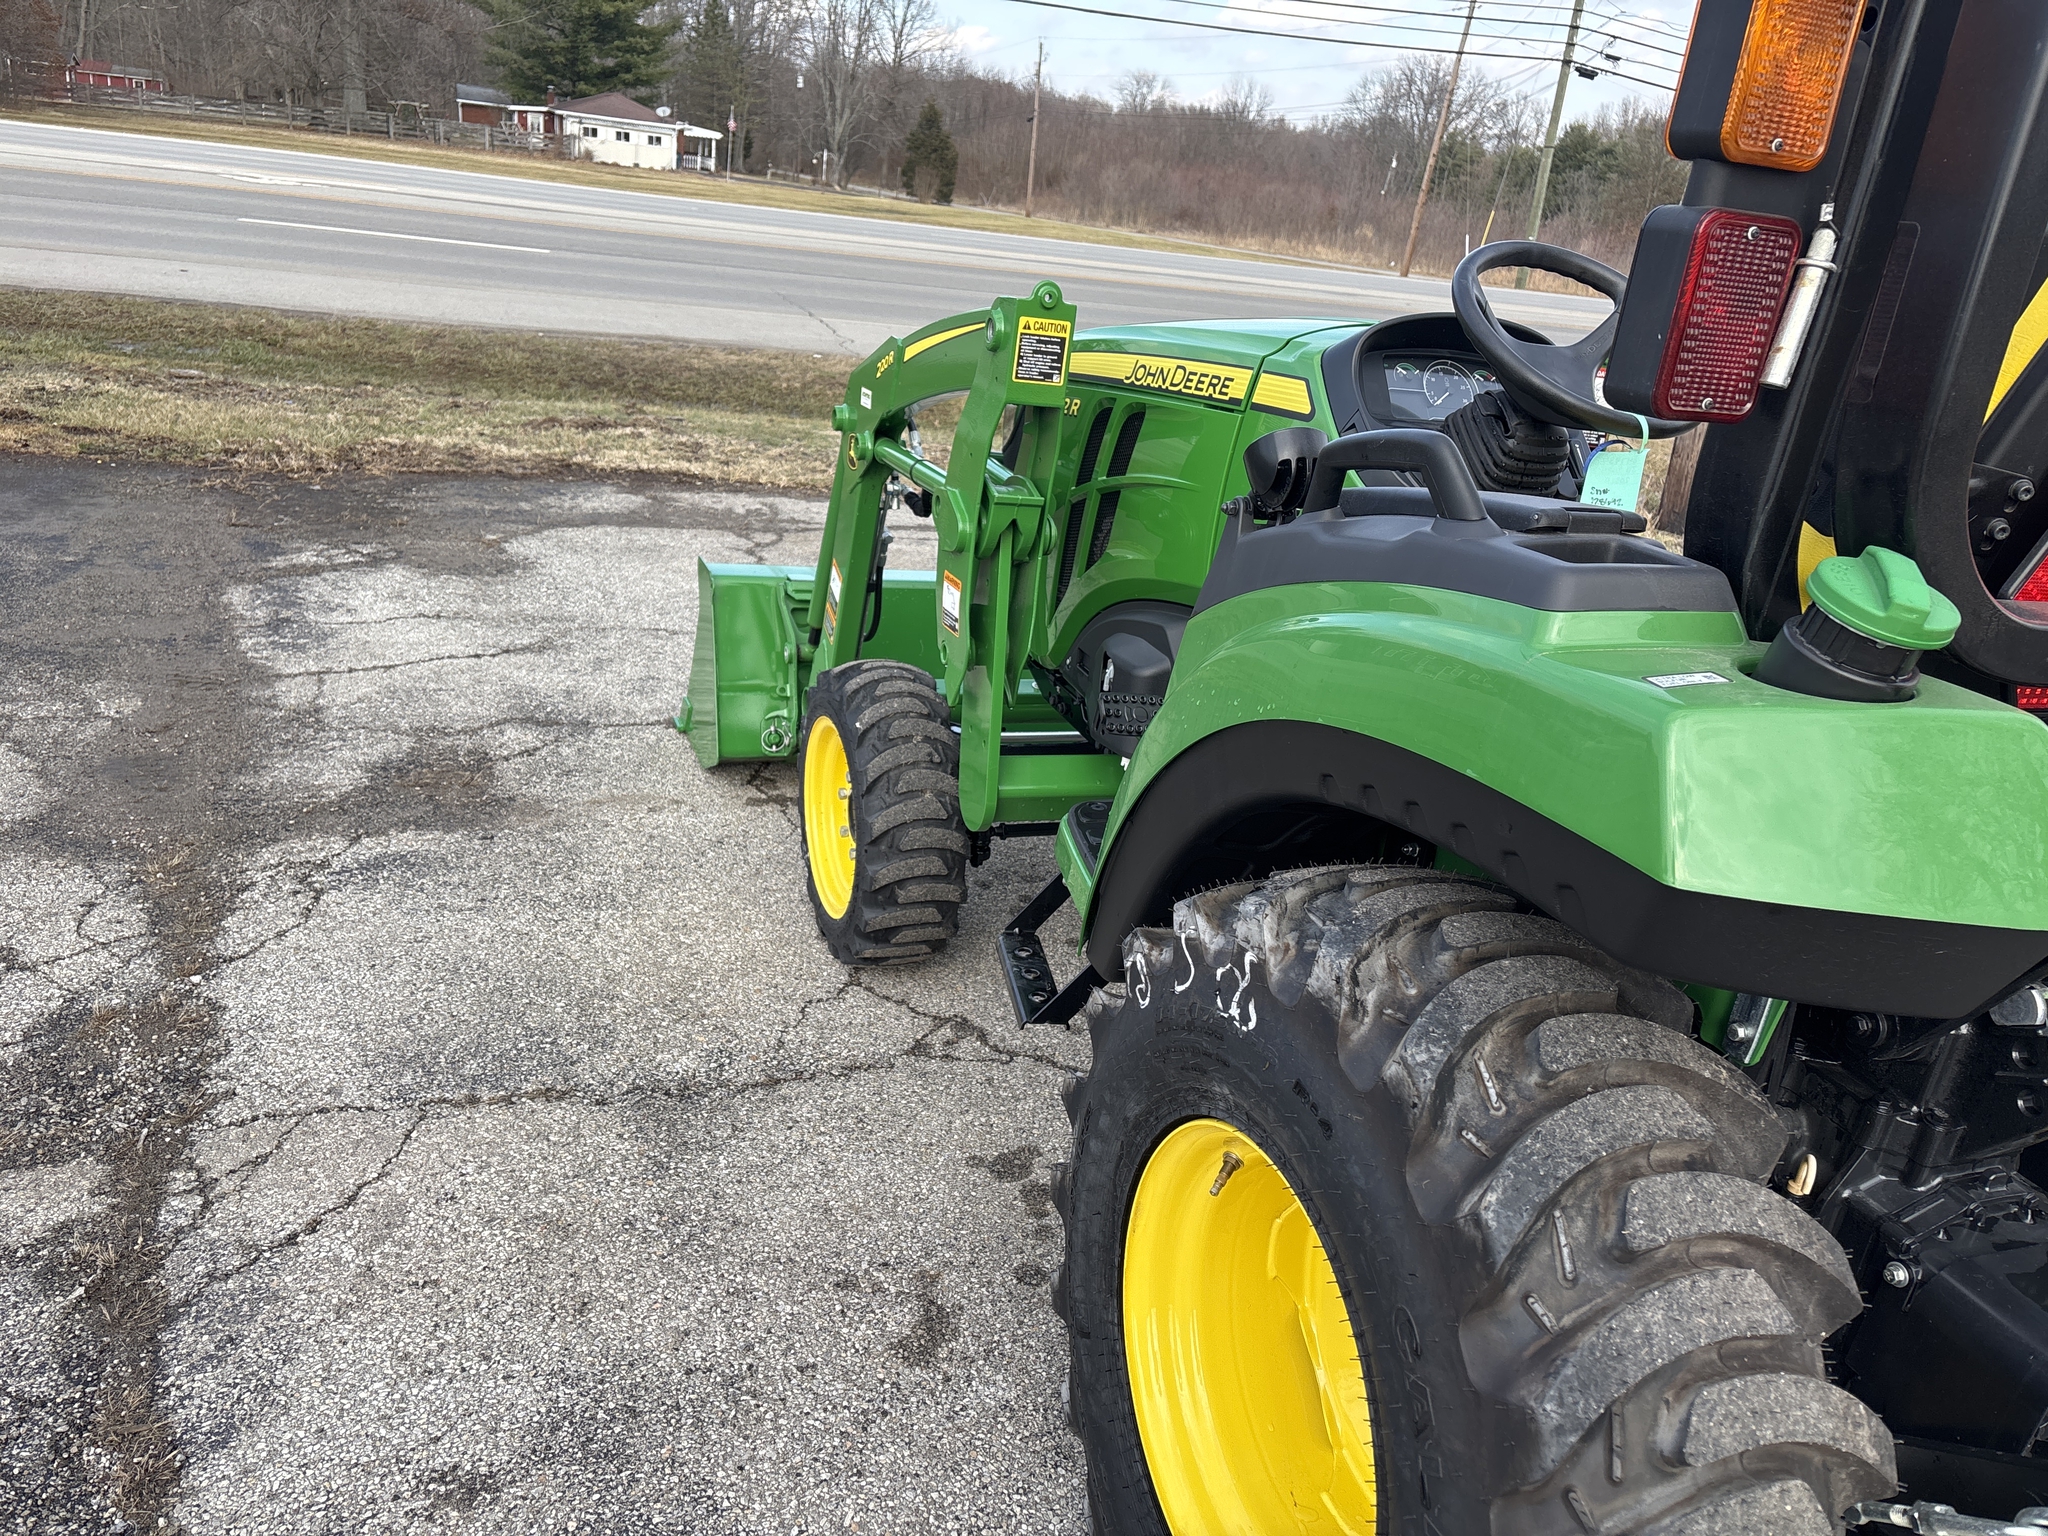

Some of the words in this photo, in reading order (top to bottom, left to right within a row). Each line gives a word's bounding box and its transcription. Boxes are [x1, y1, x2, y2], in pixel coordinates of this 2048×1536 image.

[1033, 321, 1068, 334] CAUTION
[876, 350, 895, 379] 220R
[1124, 359, 1171, 388] JOHN
[1170, 364, 1235, 398] DEERE
